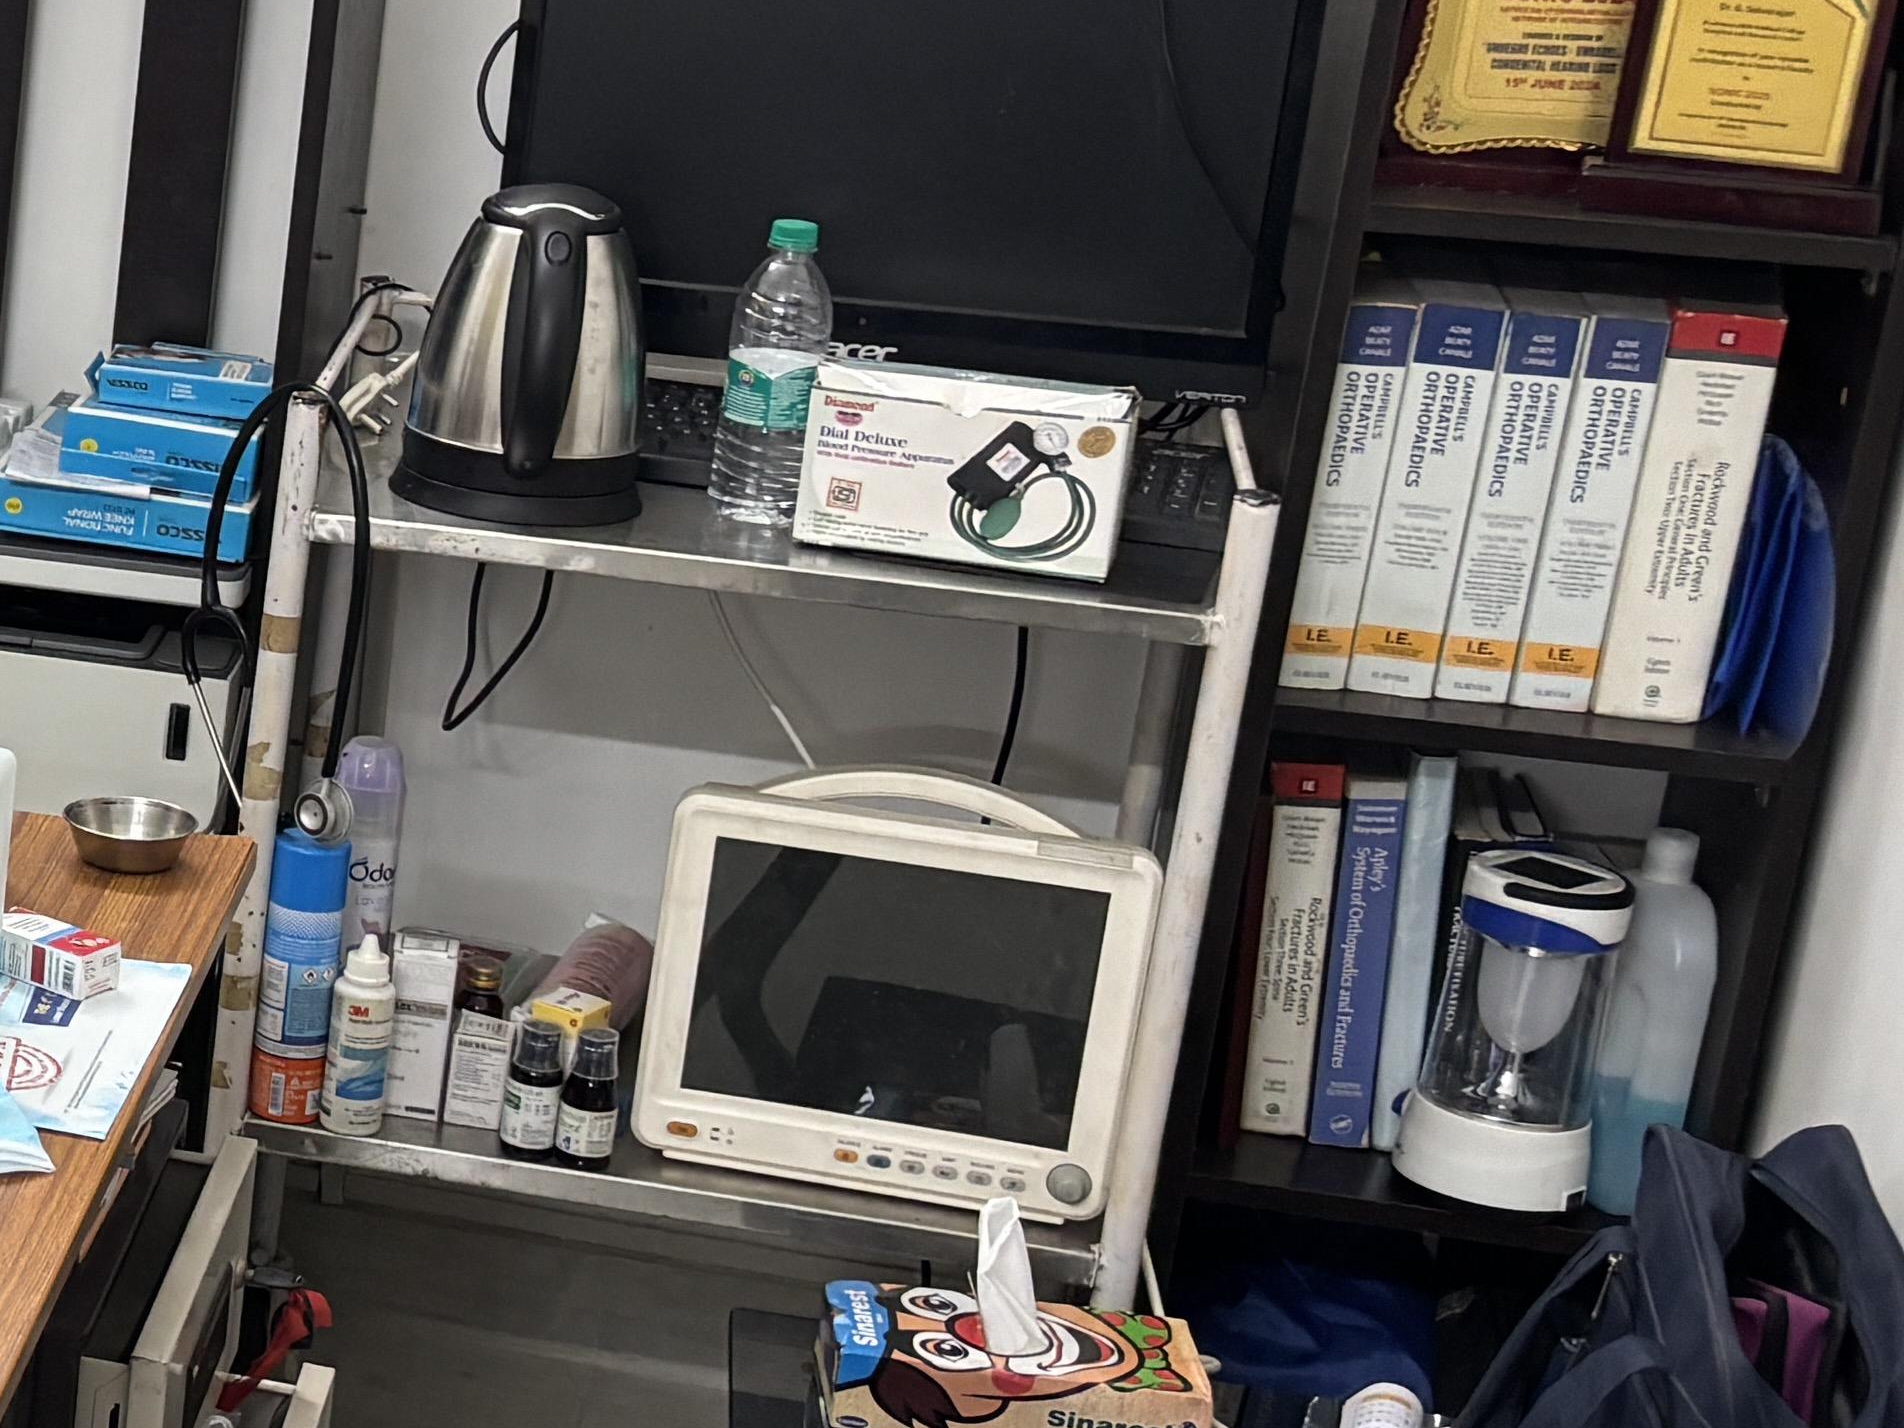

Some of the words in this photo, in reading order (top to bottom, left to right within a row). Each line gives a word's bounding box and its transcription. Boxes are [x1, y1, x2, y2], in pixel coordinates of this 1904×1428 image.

[823, 394, 876, 414] Diamond
[1351, 372, 1379, 455] OPERATIVE
[1430, 373, 1459, 457] OPERATIVE
[1513, 381, 1543, 466] OPERATIVE
[819, 425, 850, 441] Dial
[853, 430, 909, 449] Deluxe
[850, 442, 897, 459] Pressure
[1325, 370, 1361, 488] ORTHOPAEDICS
[1404, 370, 1441, 488] ORTHOPAEDICS
[1487, 380, 1524, 498] ORTHOPAEDICS
[1570, 385, 1607, 504] ORTHOPAEDICS
[1594, 386, 1627, 473] OPERATIVE
[1686, 472, 1712, 530] Fractures
[1702, 461, 1732, 527] Rockwood
[103, 512, 136, 525] KNEE
[156, 523, 206, 543] SSCO
[1684, 531, 1698, 544] in
[1697, 528, 1716, 553] and
[1674, 544, 1697, 589] Adults
[1686, 554, 1709, 604] Green's
[1350, 846, 1371, 892] System
[1368, 847, 1389, 893] Apley's
[1349, 892, 1366, 908] of
[1288, 908, 1307, 962] Fractures
[1303, 897, 1324, 957] Rockwood
[1340, 907, 1364, 987] Orthopaedics
[1287, 962, 1300, 975] in
[1300, 957, 1314, 982] and
[348, 1004, 370, 1018] 3M
[1282, 976, 1298, 1014] Adults
[1295, 982, 1313, 1028] Green's
[1337, 988, 1353, 1013] and
[1331, 1015, 1353, 1070] Fractures
[851, 1288, 879, 1349] Sinarest
